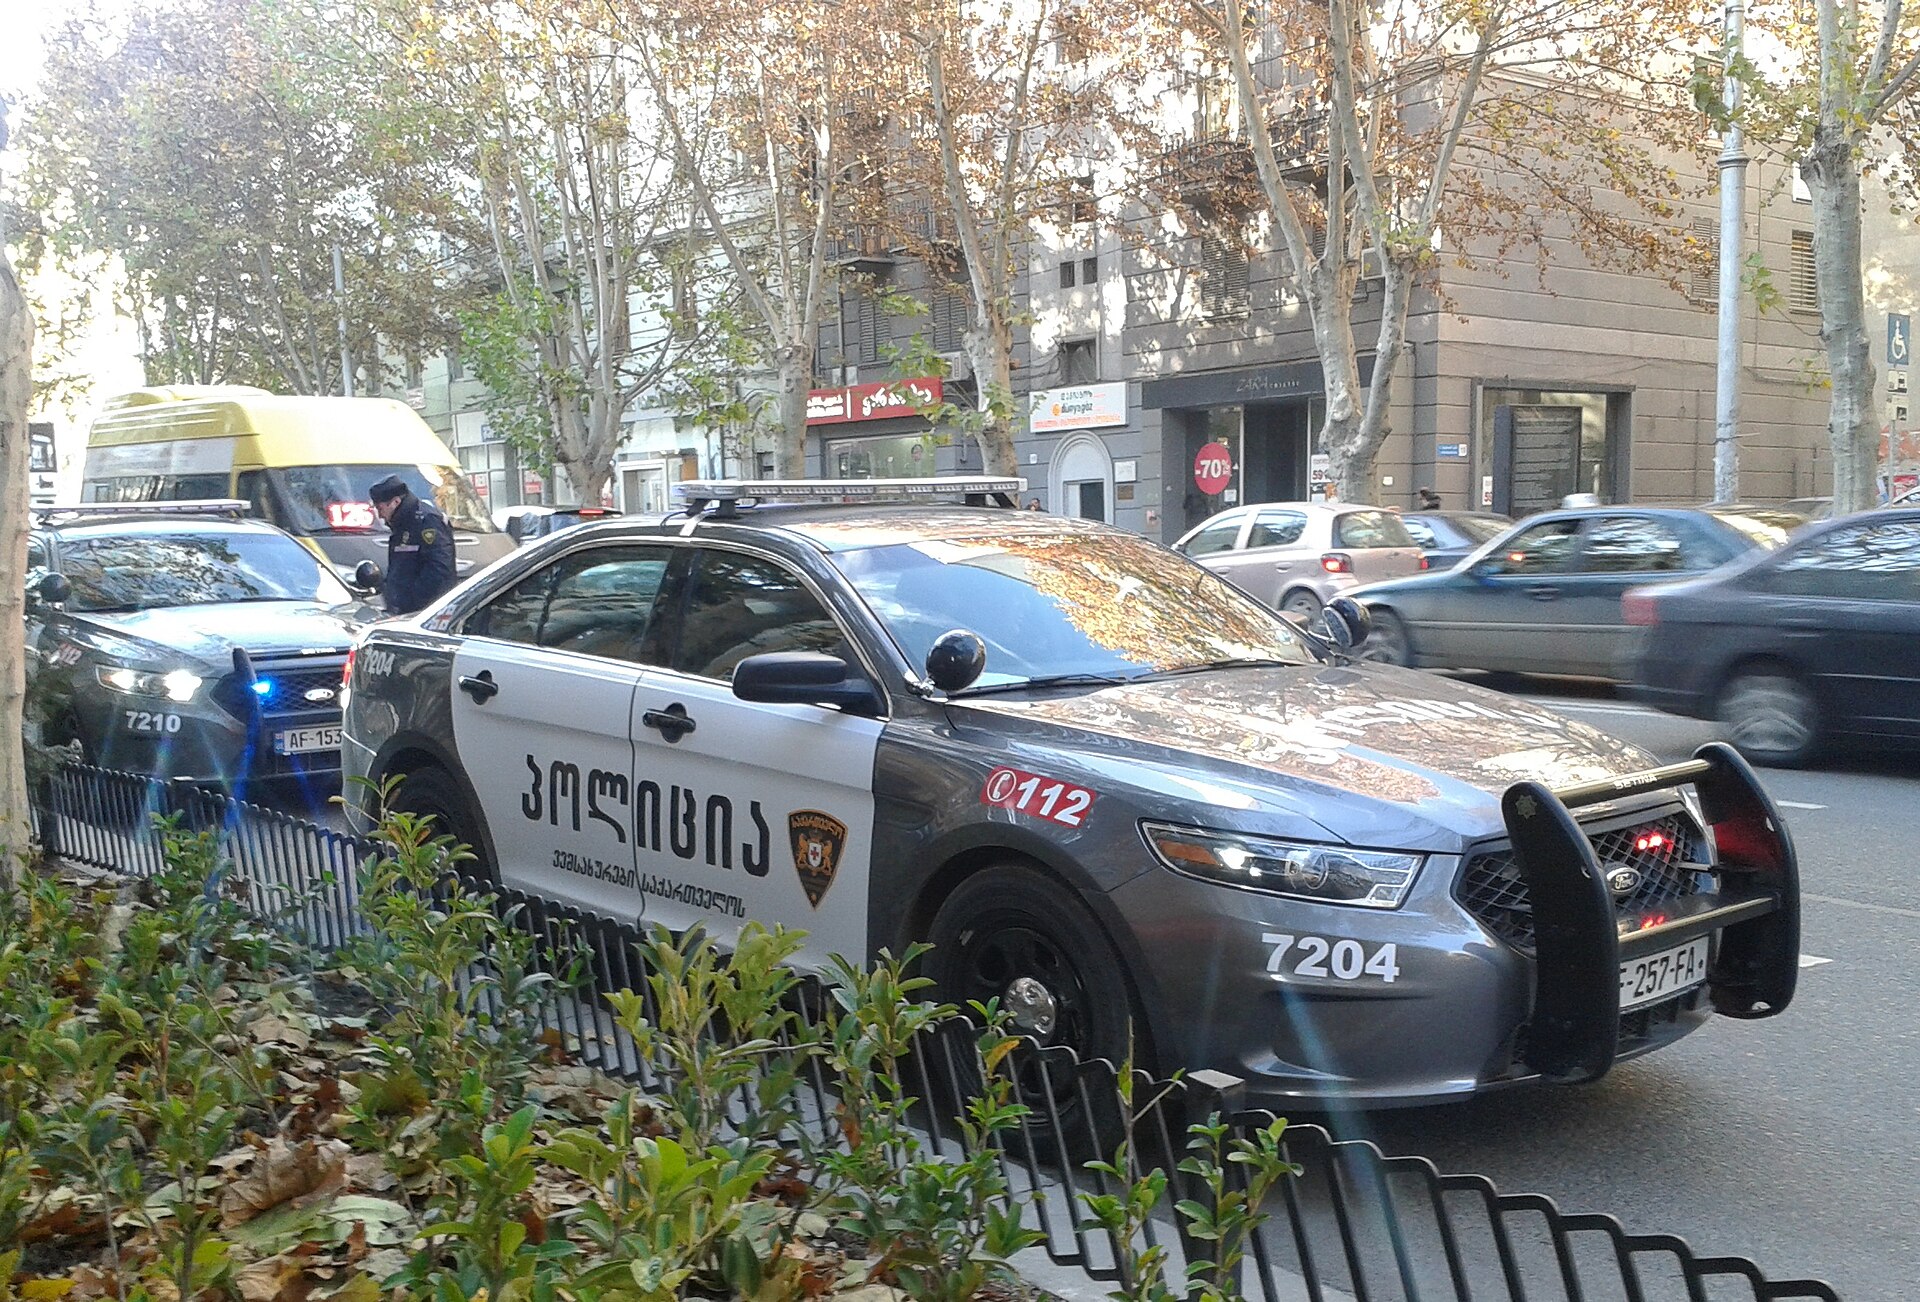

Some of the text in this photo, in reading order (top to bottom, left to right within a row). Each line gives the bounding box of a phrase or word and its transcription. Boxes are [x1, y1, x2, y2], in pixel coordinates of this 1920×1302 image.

[363, 645, 396, 677] 7204
[125, 711, 181, 733] 7210
[522, 754, 770, 877] პოლიცია
[1016, 777, 1091, 826] 112
[553, 850, 746, 918] ვემსახურები საქართველოს
[1262, 932, 1400, 983] 7204
